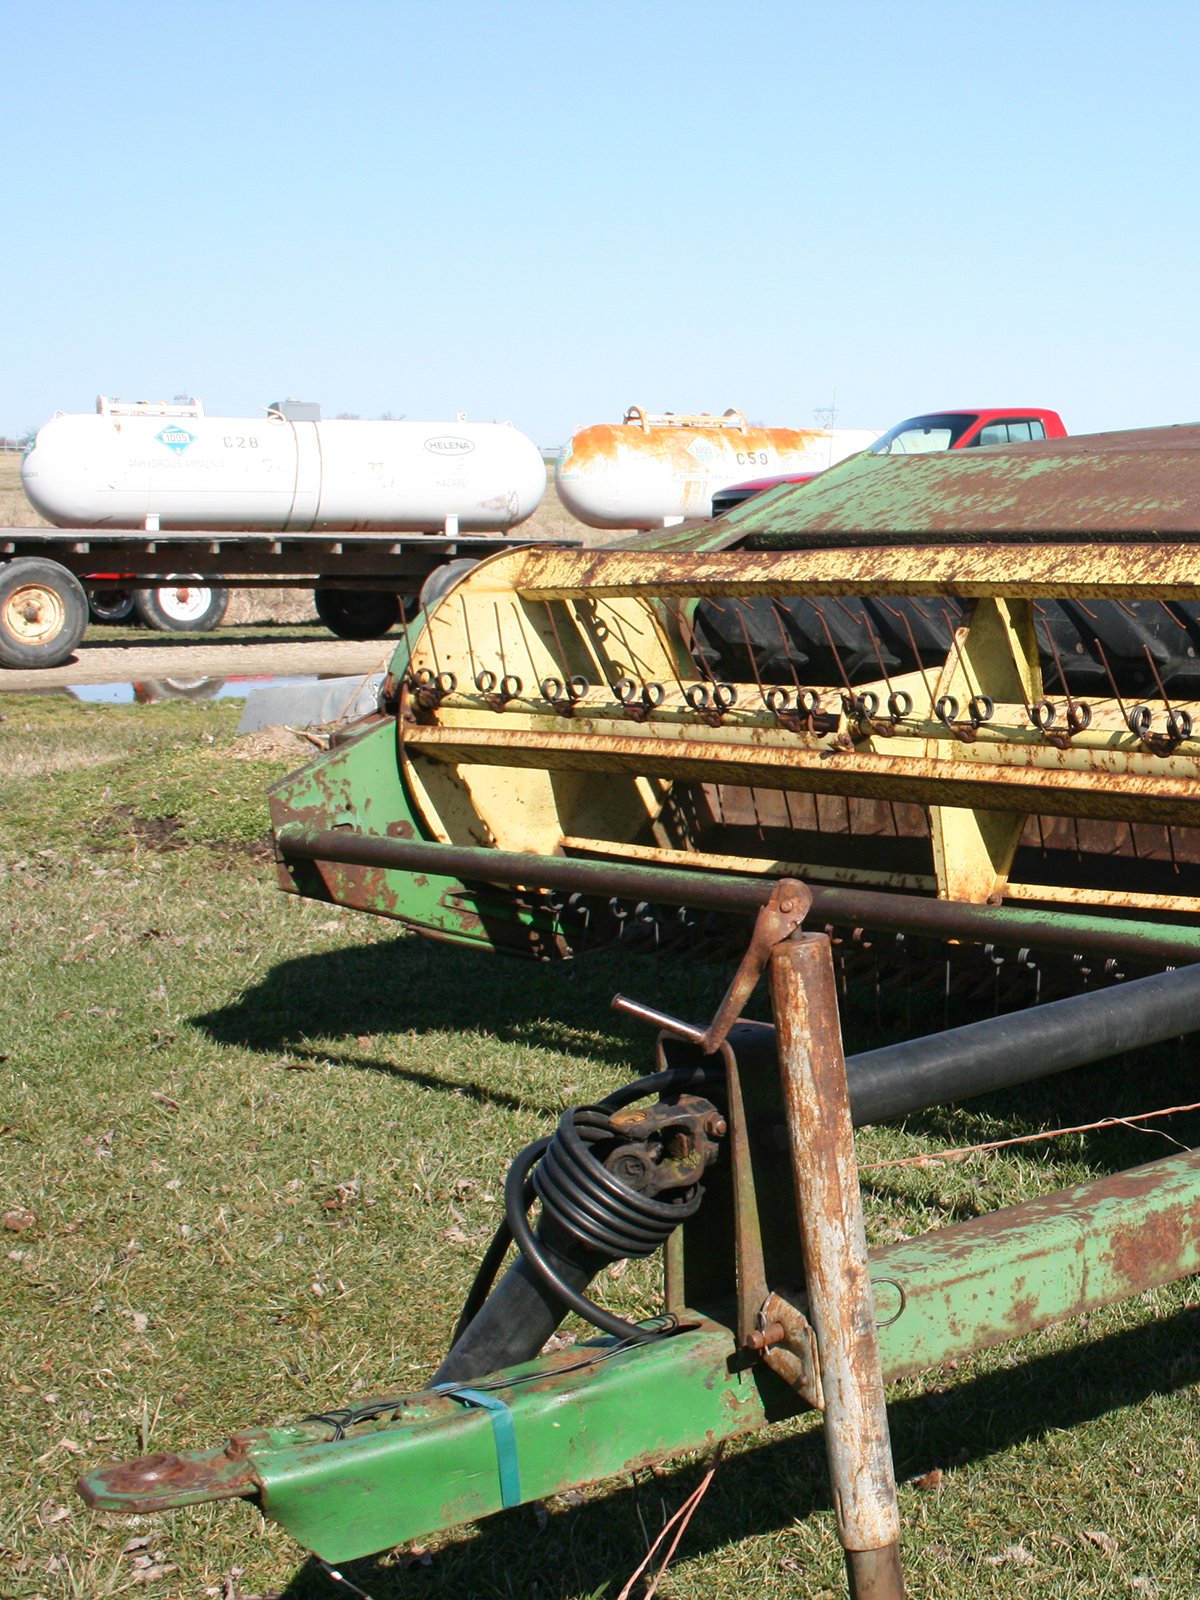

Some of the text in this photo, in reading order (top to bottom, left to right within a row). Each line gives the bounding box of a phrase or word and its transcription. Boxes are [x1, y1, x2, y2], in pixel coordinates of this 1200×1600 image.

[166, 433, 187, 442] 1005
[223, 436, 259, 448] C28
[429, 441, 470, 449] HELENA
[736, 452, 768, 465] C59
